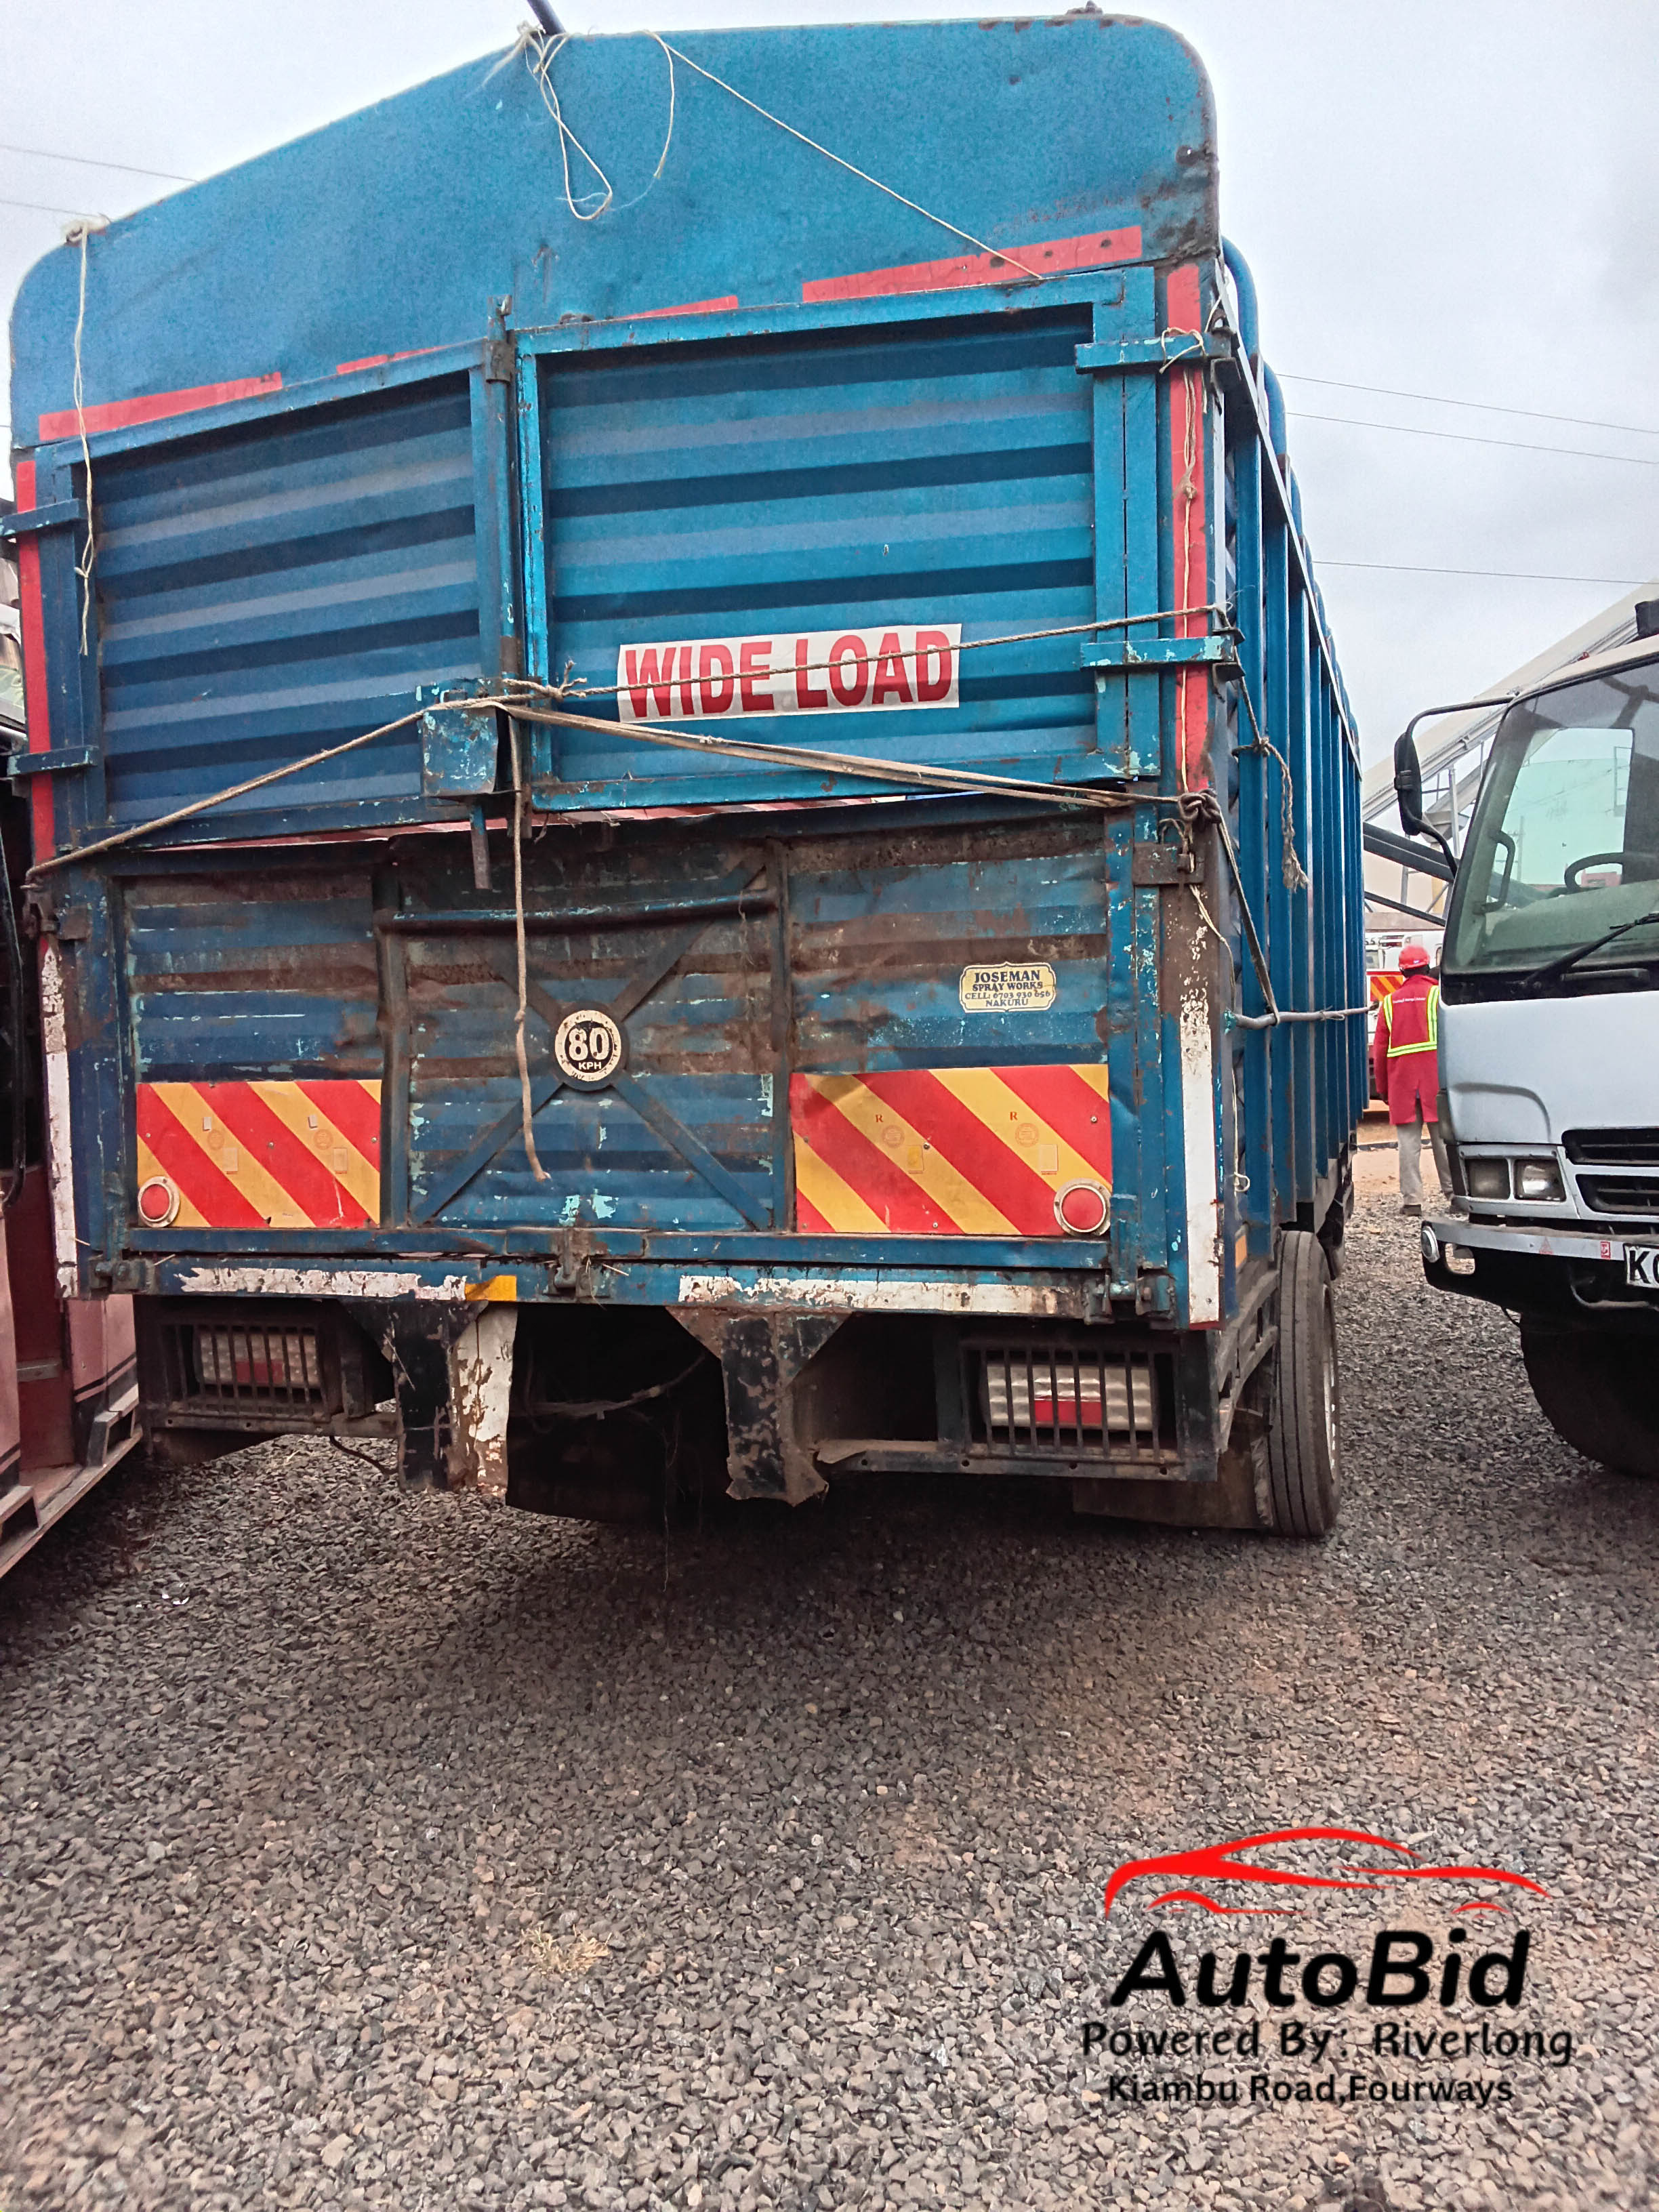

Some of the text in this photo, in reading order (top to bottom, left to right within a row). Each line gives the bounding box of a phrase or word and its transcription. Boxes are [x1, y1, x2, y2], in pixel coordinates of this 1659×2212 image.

[625, 631, 952, 718] WIDE LOAD
[975, 970, 1040, 983] JOSEMAN
[972, 981, 1044, 992] SPRAY WORKS
[993, 992, 1014, 1000] 0703
[985, 998, 1029, 1007] NAKURU
[569, 1027, 609, 1061] 80
[578, 1061, 602, 1070] KPH
[876, 1114, 884, 1122] R
[1010, 1111, 1018, 1121] R
